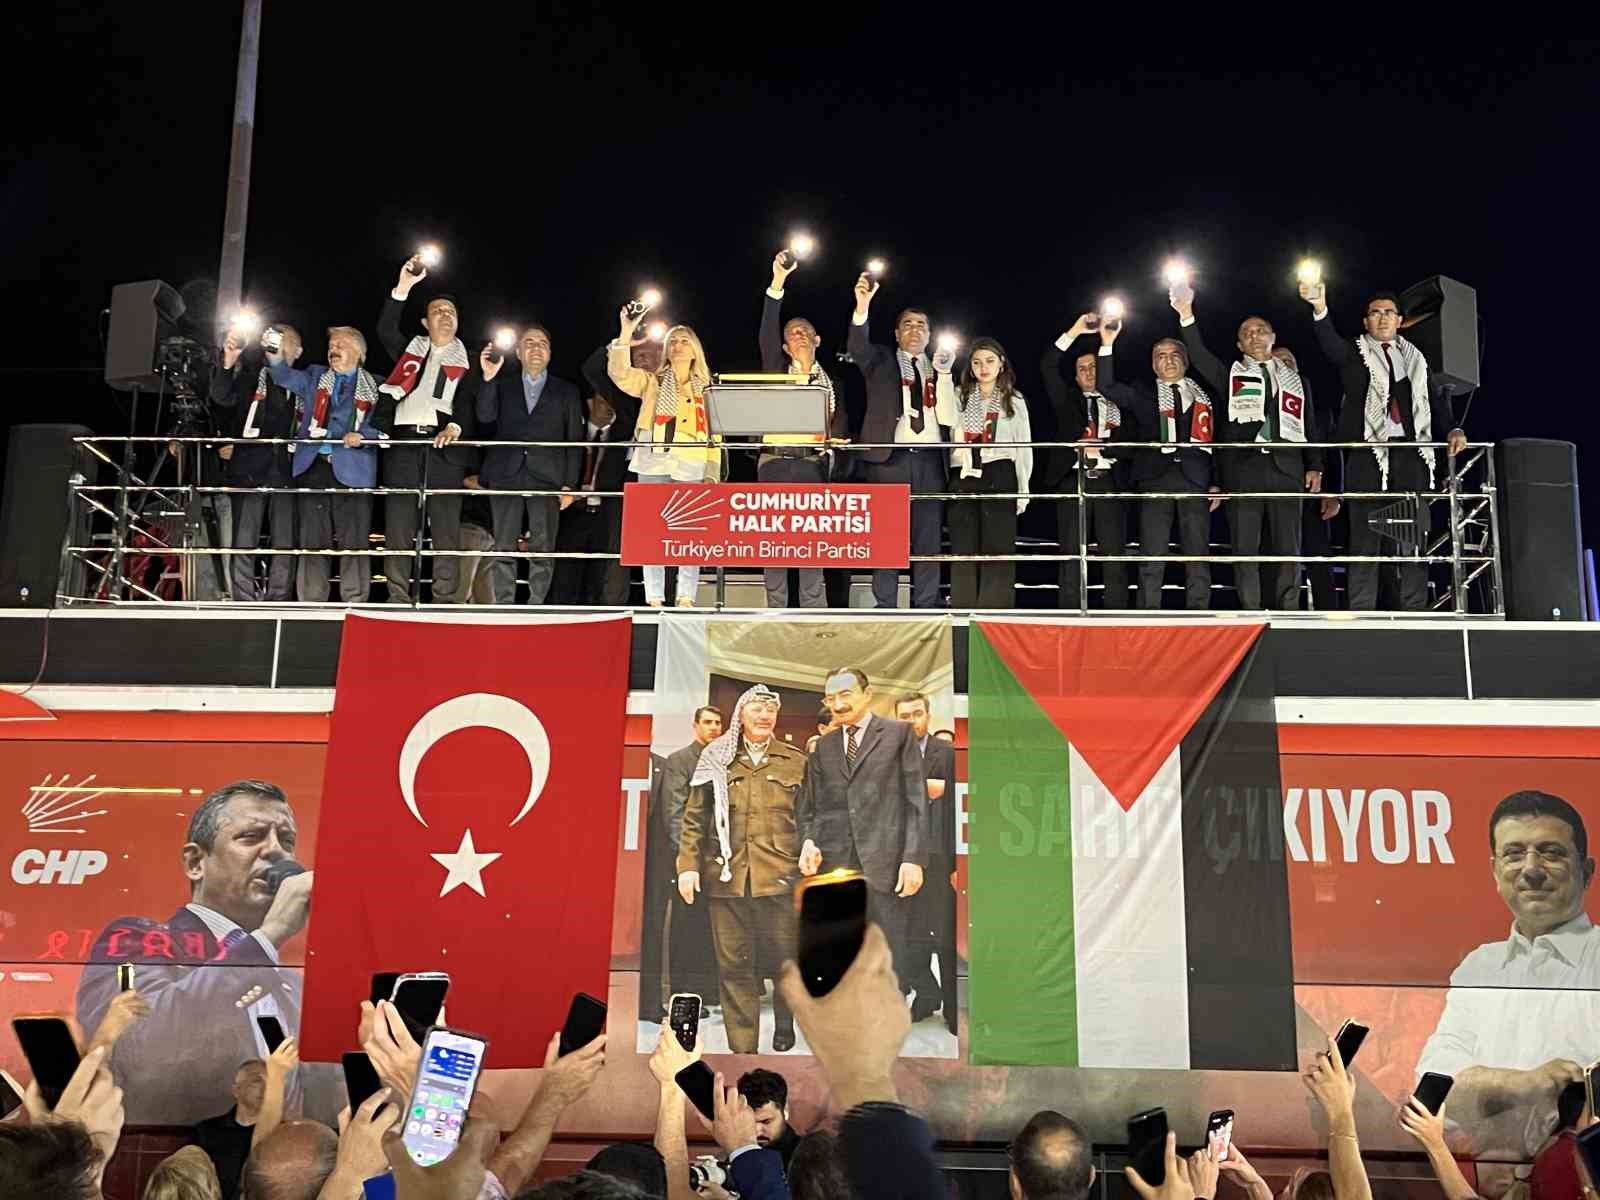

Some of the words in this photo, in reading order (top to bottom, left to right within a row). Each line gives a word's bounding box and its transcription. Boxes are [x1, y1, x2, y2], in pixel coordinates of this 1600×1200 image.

[730, 489, 871, 511] CUMHURİYET
[729, 515, 786, 533] HALK
[791, 512, 871, 533] PARTİSİ
[661, 539, 754, 561] Türkiye'nin
[759, 540, 812, 558] Birinci
[817, 541, 871, 559] Partisi
[11, 849, 108, 885] CHP
